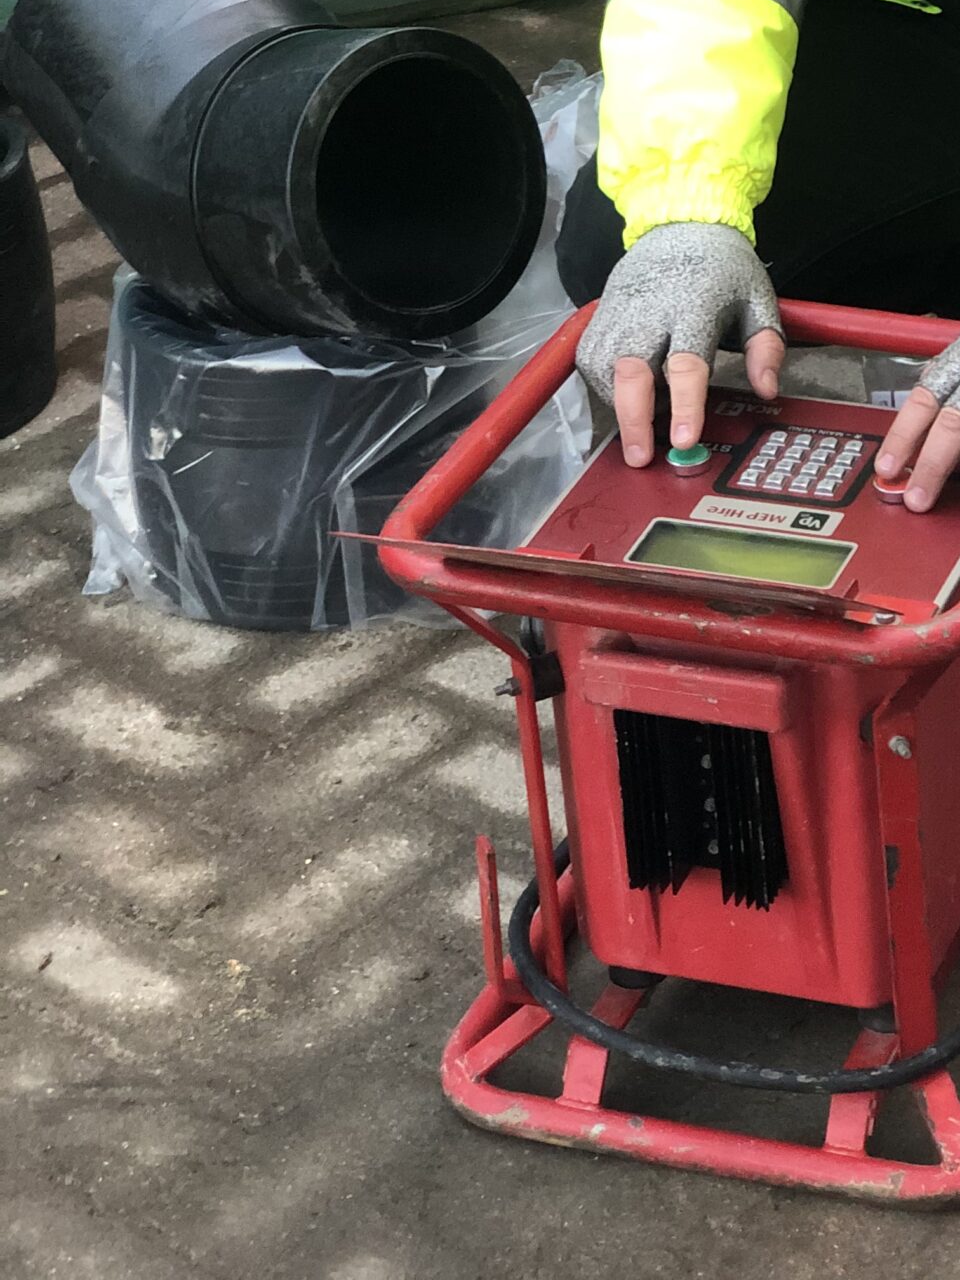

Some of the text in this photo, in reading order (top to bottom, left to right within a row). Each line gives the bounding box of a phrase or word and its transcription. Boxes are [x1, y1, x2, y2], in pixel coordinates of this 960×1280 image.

[707, 505, 787, 524] MEP Hire
[799, 516, 821, 529] Vp
